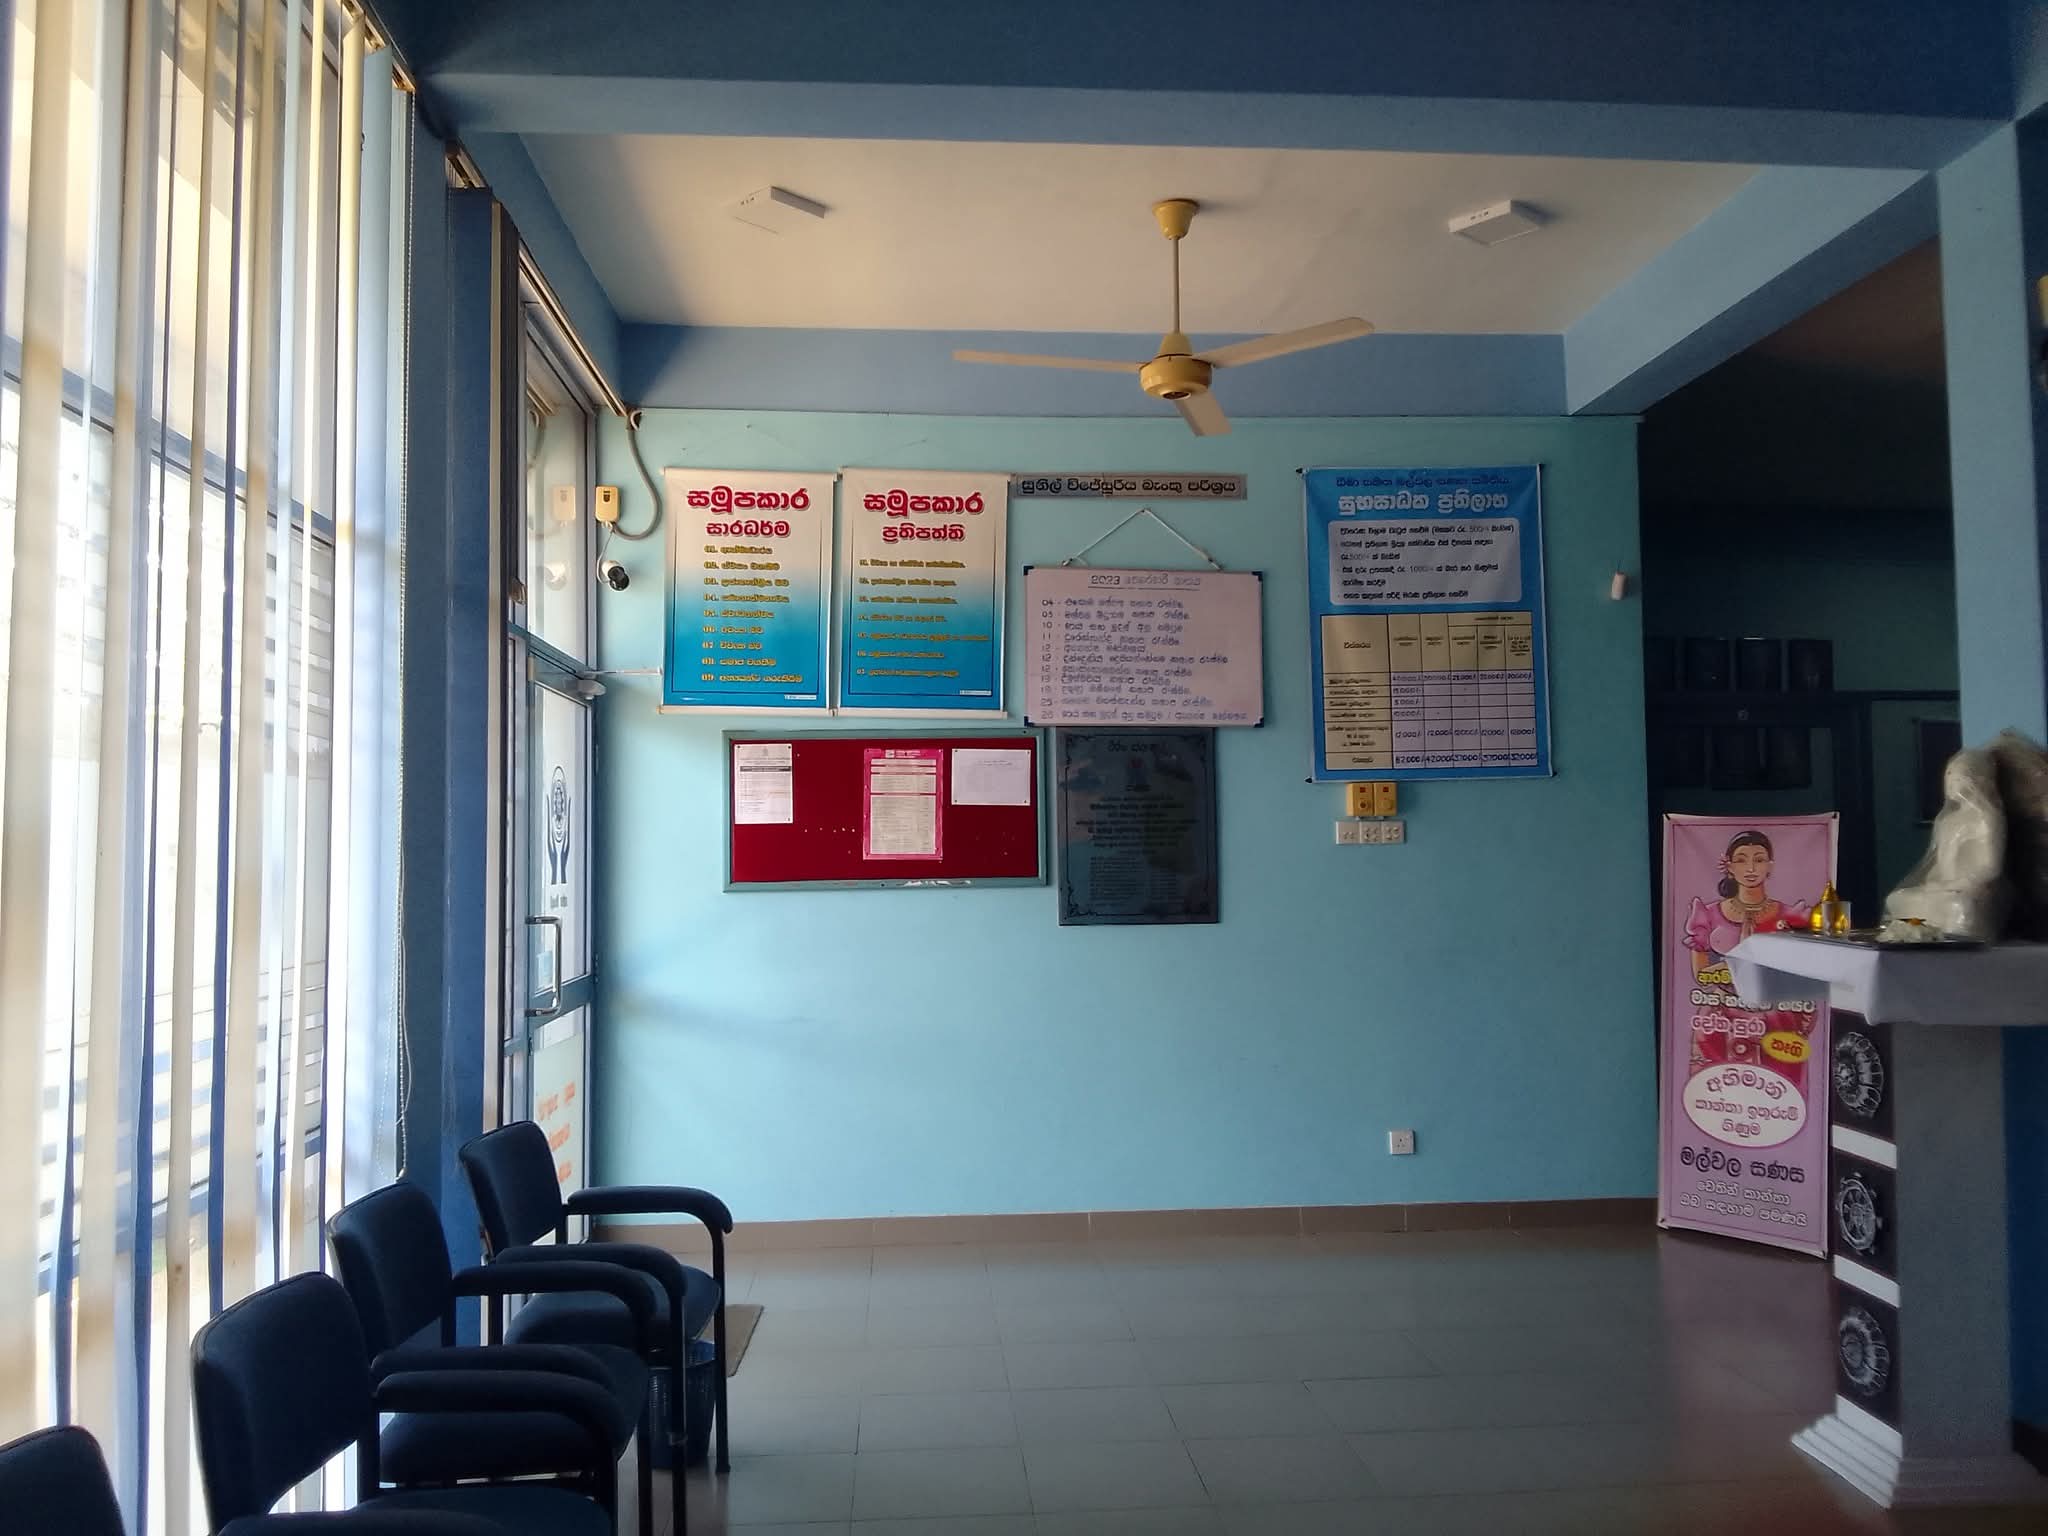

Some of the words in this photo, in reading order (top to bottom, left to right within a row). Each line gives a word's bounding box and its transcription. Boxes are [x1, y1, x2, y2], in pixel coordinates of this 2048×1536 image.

[1142, 479, 1183, 494] බැංකු
[687, 485, 810, 514] සමූපකාර
[864, 488, 984, 517] සමූපකාර
[706, 520, 790, 537] සාරධර්ම
[882, 523, 965, 543] ප්‍රතිපත්ති
[1091, 575, 1120, 585] 2023
[1691, 988, 1720, 1006] මාස
[1771, 1038, 1804, 1057] තෑගි
[1695, 1098, 1743, 1115] කාන්තා
[1748, 1104, 1800, 1122] ඉතුරුම්
[1722, 1118, 1761, 1138] ගිණුම
[1680, 1146, 1742, 1178] මල්වල
[1750, 1160, 1806, 1183] සණස
[1744, 1187, 1791, 1205] කාන්තා
[1704, 1200, 1754, 1217] සඳහාම
[1759, 1207, 1808, 1227] පමණයි
